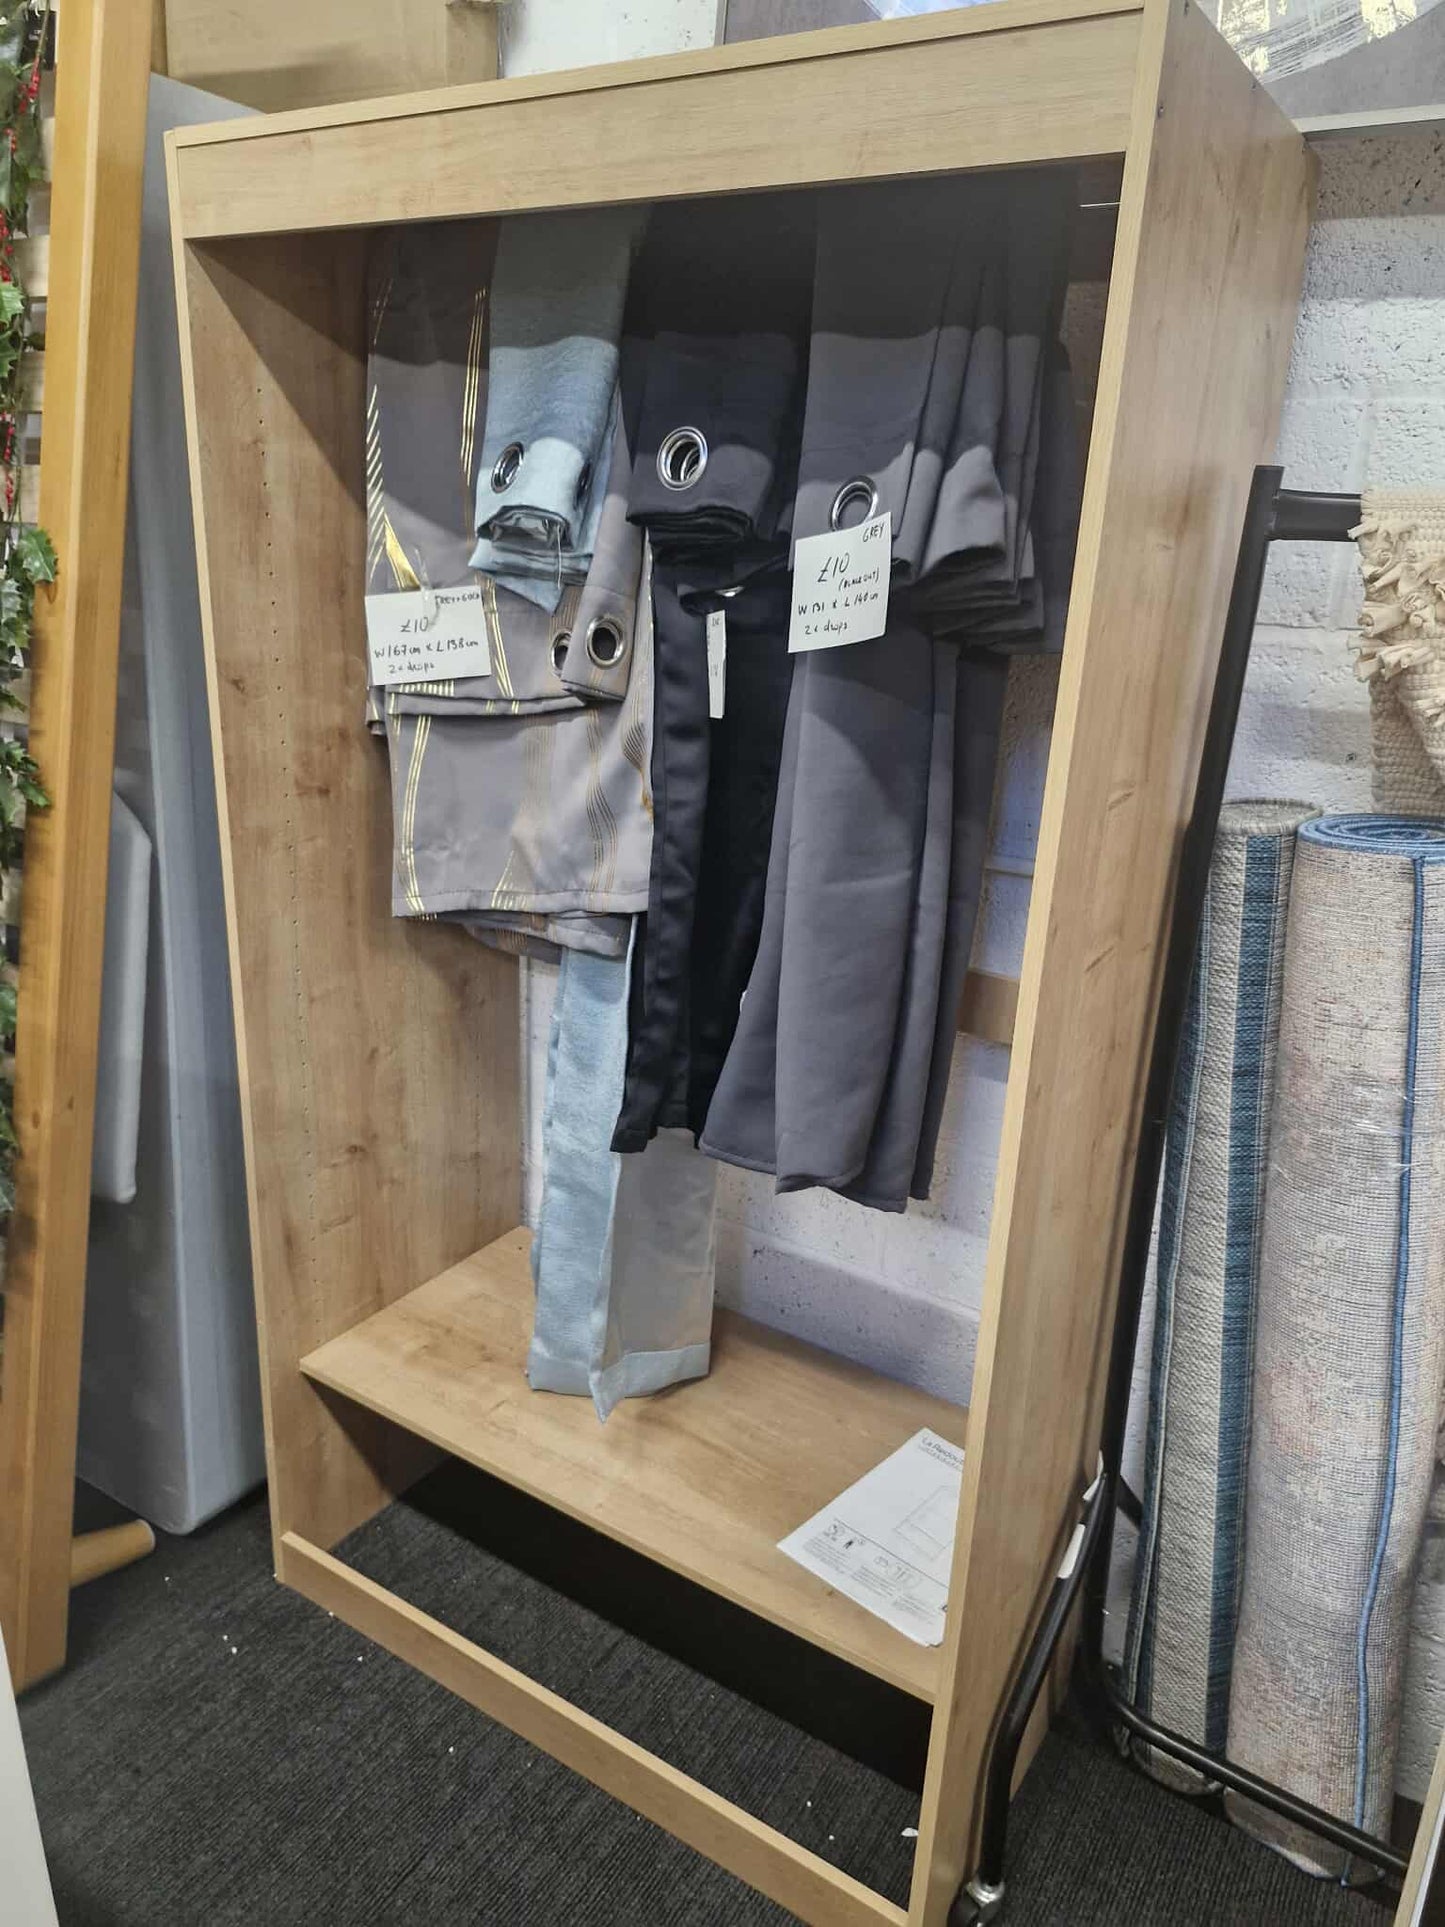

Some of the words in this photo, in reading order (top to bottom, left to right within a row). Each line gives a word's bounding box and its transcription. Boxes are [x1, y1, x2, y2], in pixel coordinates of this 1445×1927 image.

[862, 524, 885, 543] GREY
[817, 552, 850, 583] £10
[400, 616, 430, 633] £10
